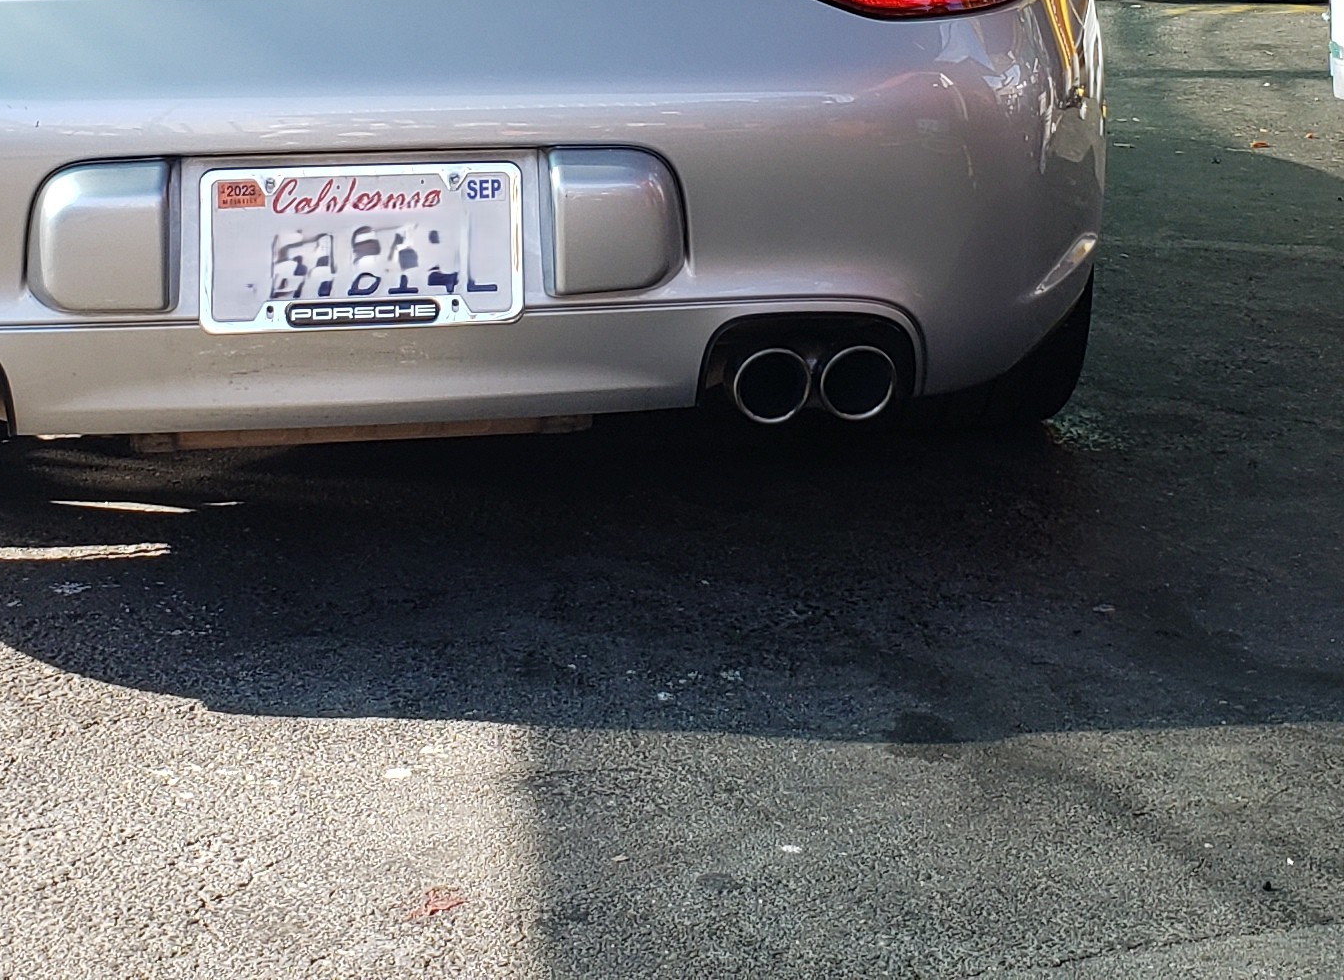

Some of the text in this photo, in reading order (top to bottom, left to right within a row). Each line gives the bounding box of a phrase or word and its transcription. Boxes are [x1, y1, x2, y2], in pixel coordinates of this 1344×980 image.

[226, 185, 256, 197] 2023
[272, 177, 442, 214] California
[467, 178, 502, 200] SEP
[290, 303, 437, 322] PORSCHE
